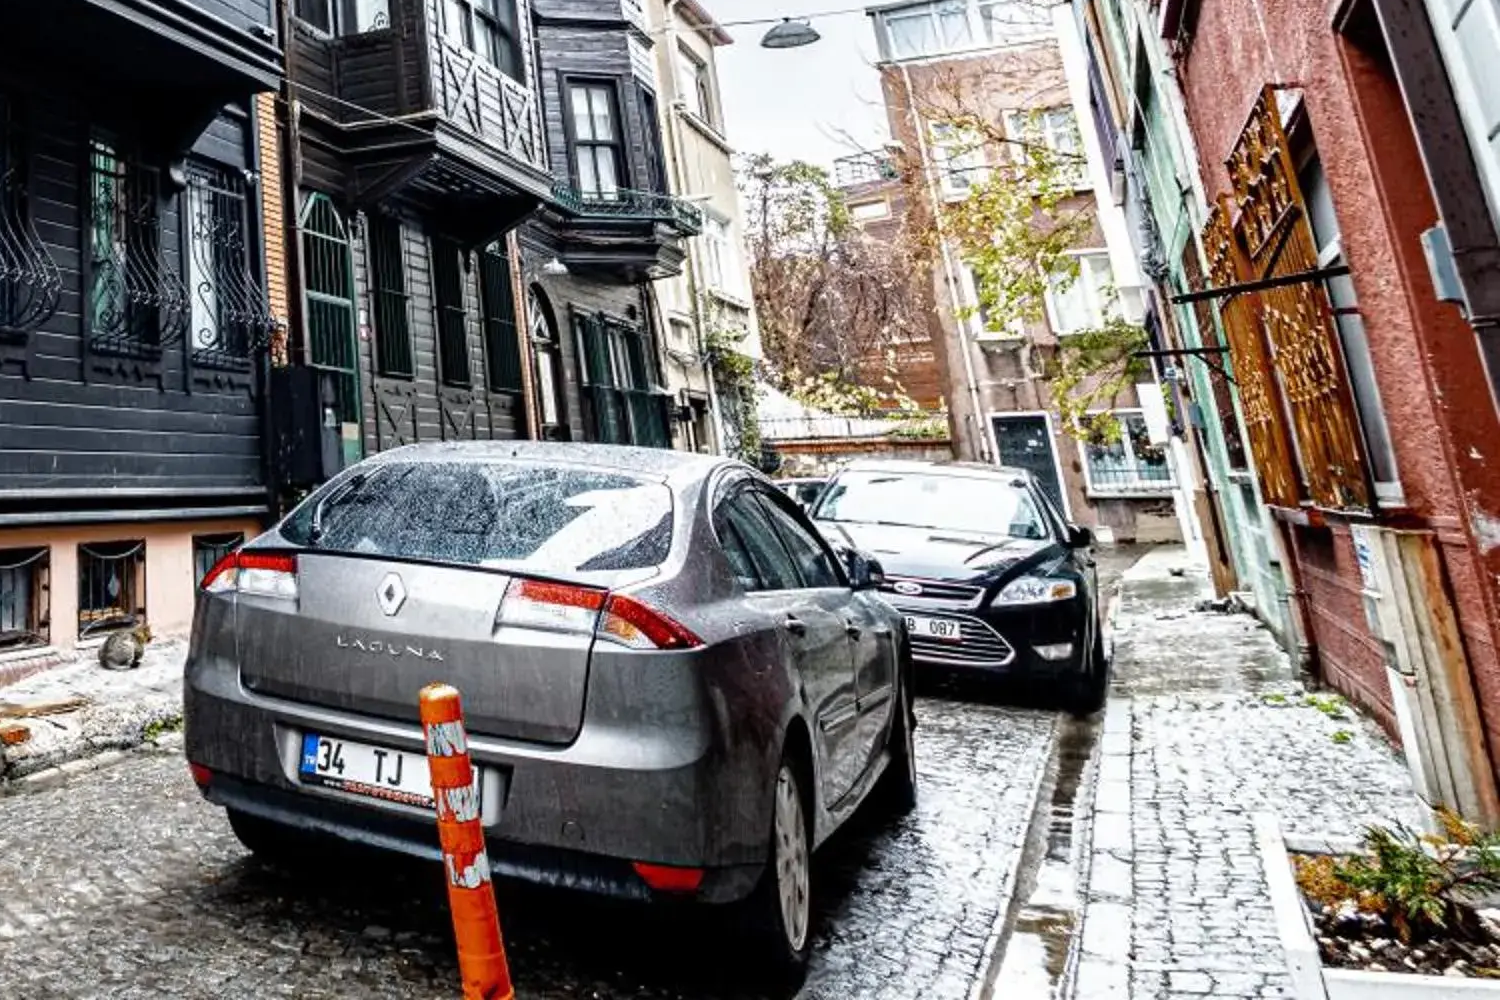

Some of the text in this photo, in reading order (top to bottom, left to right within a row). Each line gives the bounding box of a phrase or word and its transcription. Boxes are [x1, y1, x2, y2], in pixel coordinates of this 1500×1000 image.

[336, 635, 444, 661] LAGUNA
[317, 740, 403, 787] 34 TJ
